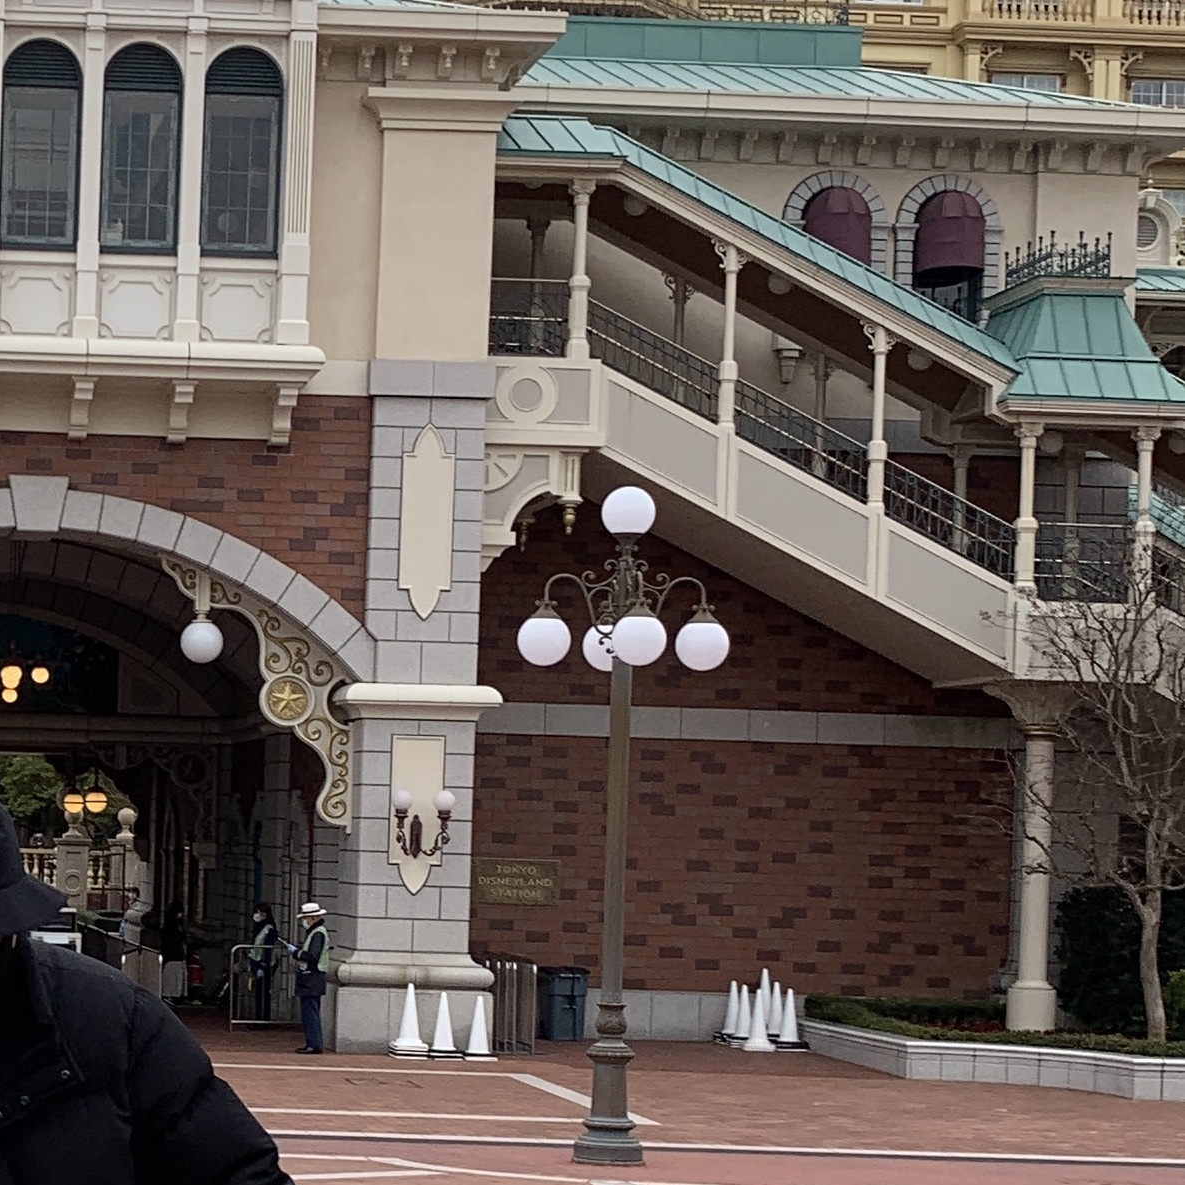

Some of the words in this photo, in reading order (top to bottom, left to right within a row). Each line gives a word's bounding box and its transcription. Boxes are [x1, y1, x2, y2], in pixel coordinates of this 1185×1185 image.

[495, 864, 537, 875] TOKYO
[478, 876, 553, 887] DISNEYLAND
[490, 888, 541, 899] STATION
